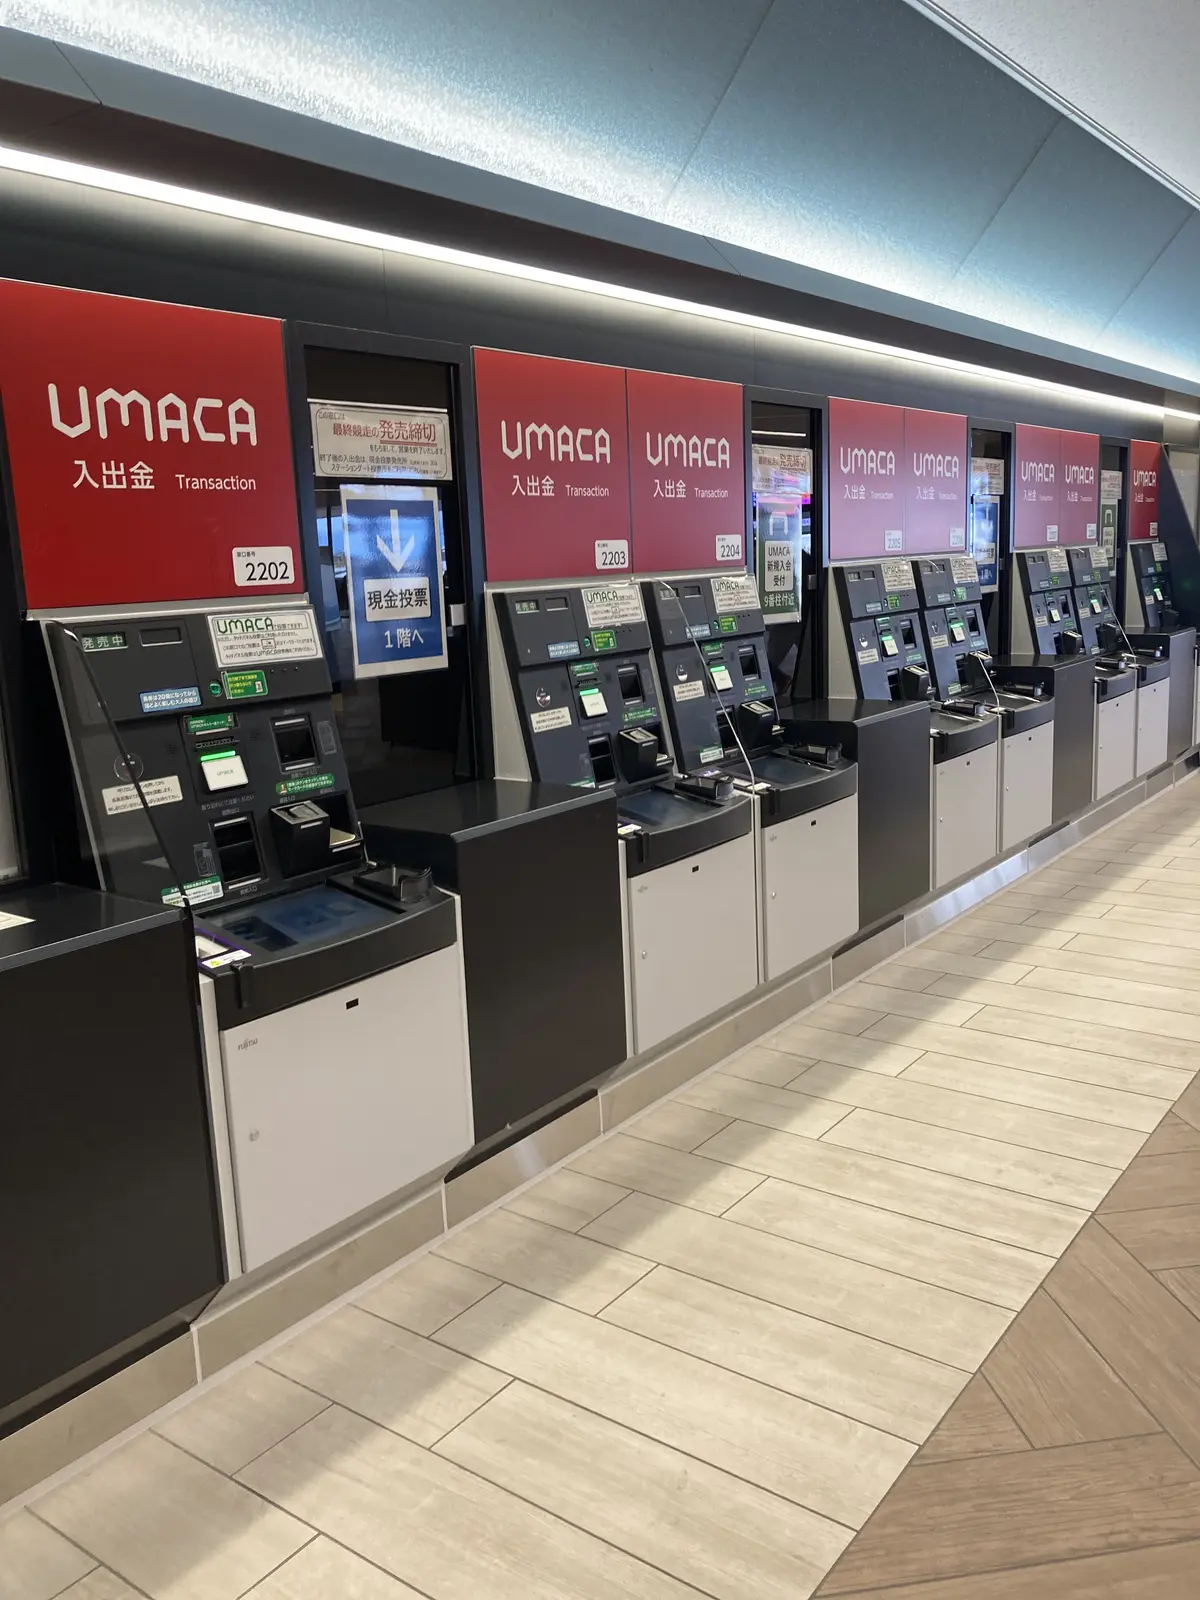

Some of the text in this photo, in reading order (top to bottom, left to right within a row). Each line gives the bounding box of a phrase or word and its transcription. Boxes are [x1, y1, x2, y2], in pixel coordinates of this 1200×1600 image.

[48, 383, 258, 446] UMACA
[501, 419, 611, 464] UMACA
[646, 431, 730, 469] UMACA
[840, 446, 896, 476] UMACA
[913, 452, 959, 479] UMACA
[73, 460, 257, 490] 入出金 Transaction
[1021, 461, 1055, 483] UMACA
[1065, 464, 1095, 485] UMACA
[1133, 469, 1157, 487] UMACA
[512, 475, 609, 497] 入出金 Transaction
[653, 479, 729, 498] 入出金 Transaction
[843, 485, 866, 500] 入出金
[916, 486, 935, 500] 入出金
[601, 551, 627, 566] 2203
[720, 544, 741, 558] 2204
[768, 546, 791, 556] UMACA
[245, 562, 290, 581] 2202
[767, 560, 792, 572] 新規入会
[716, 581, 740, 592] UMACA
[773, 575, 786, 587] 受付
[367, 587, 428, 610] 現金投票
[586, 590, 618, 603] UMACA
[217, 617, 273, 633] UMACA
[82, 634, 123, 649] 発売中
[384, 629, 424, 649] 1階へ
